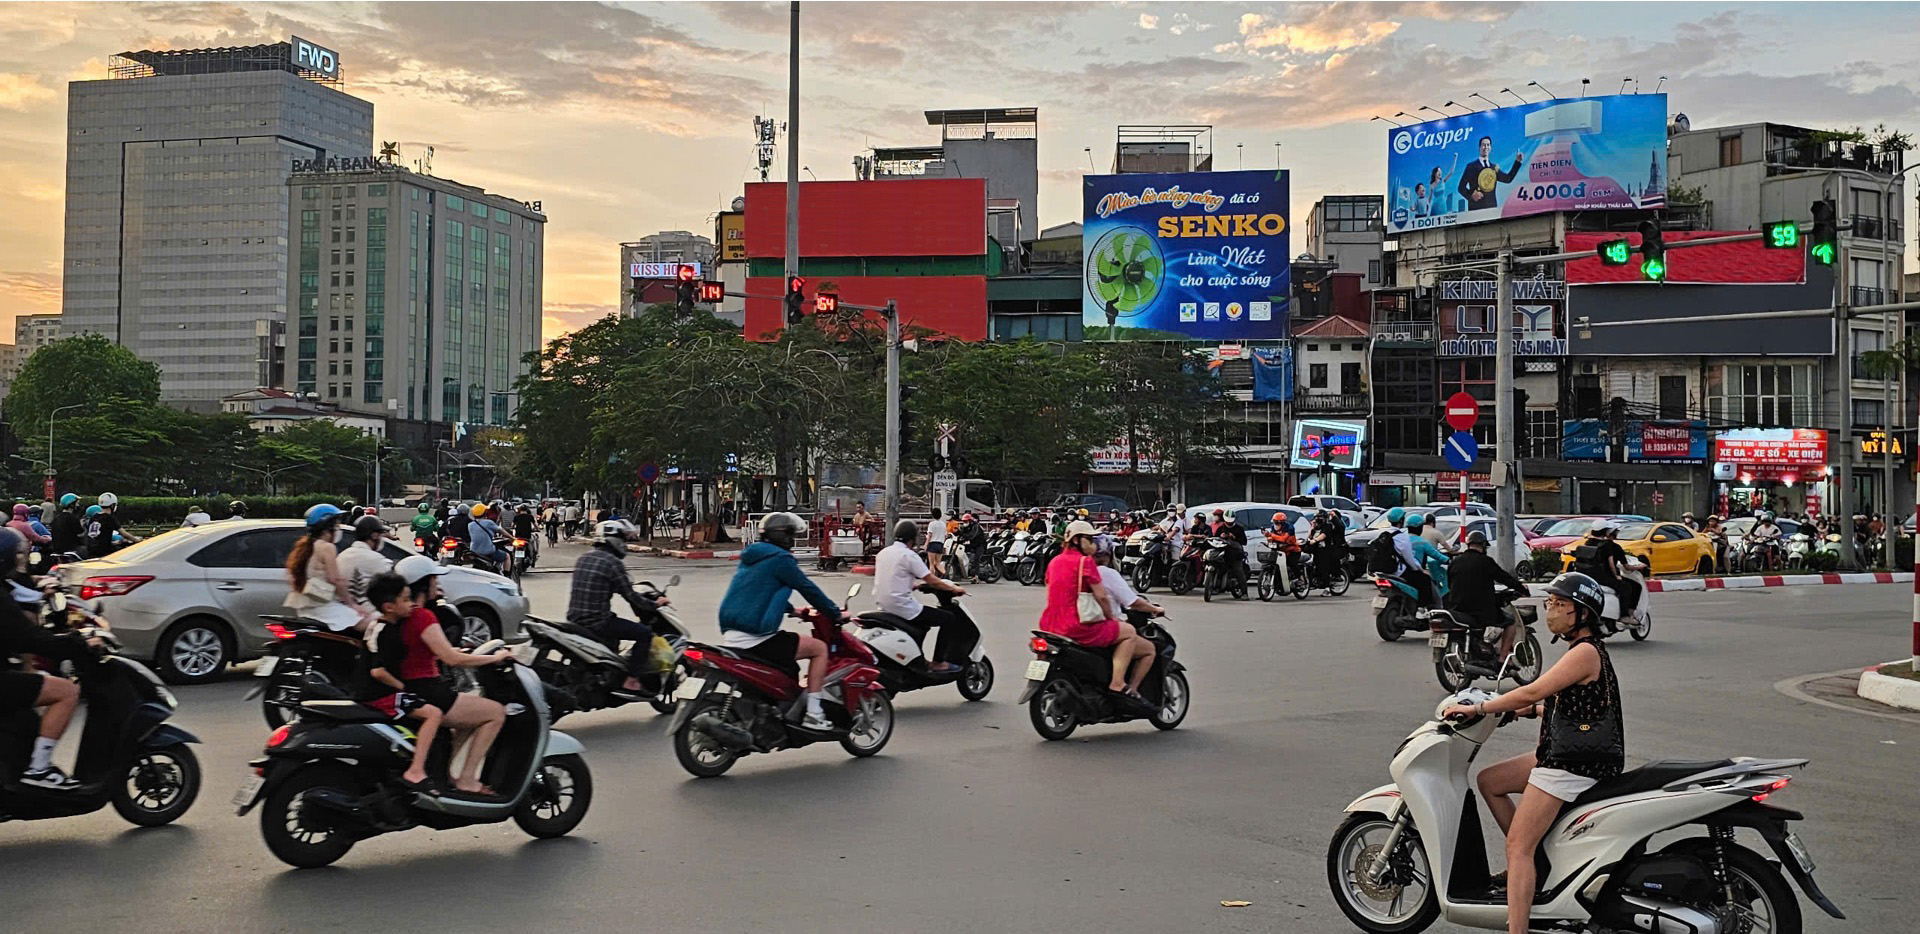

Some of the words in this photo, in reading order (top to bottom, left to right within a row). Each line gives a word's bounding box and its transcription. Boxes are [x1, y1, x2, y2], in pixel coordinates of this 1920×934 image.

[298, 41, 335, 73] FWD
[1414, 127, 1474, 149] Casper
[340, 156, 385, 172] BANK
[1230, 193, 1245, 204] đã
[1246, 192, 1260, 203] có
[1157, 213, 1286, 238] SENKO
[1772, 225, 1796, 247] 59
[1188, 251, 1218, 266] Làm
[1221, 245, 1267, 268] Mát
[1606, 243, 1628, 263] 48
[633, 264, 660, 276] KISS
[1180, 274, 1204, 287] cho
[1208, 273, 1239, 289] cuộc
[1240, 271, 1272, 288] sống
[1443, 276, 1498, 300] KÍNH
[1511, 272, 1564, 300] MẮT
[1457, 305, 1553, 334] LIY
[1519, 339, 1535, 355] 45
[1720, 448, 1732, 457] XE
[1733, 448, 1746, 457] GA
[1753, 449, 1765, 457] XE
[1767, 447, 1780, 457] SỐ
[1788, 449, 1800, 458] XE
